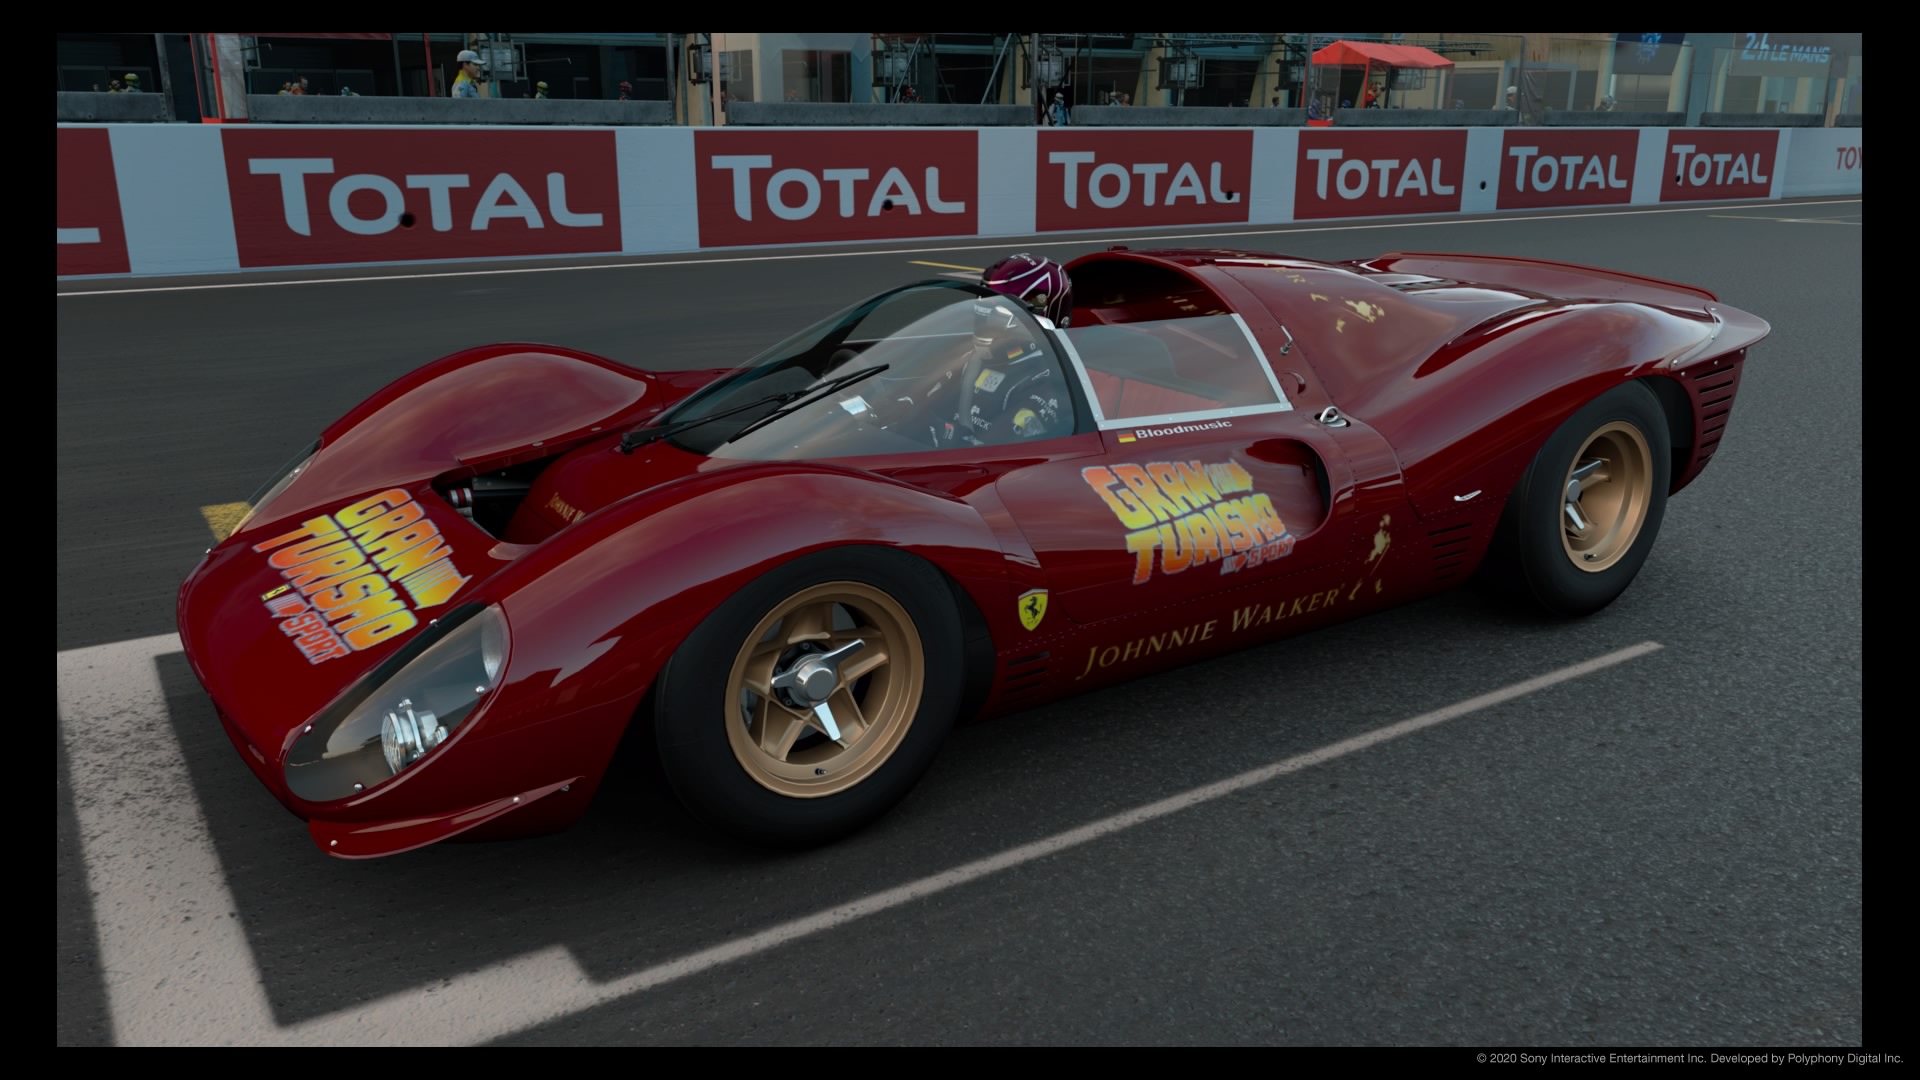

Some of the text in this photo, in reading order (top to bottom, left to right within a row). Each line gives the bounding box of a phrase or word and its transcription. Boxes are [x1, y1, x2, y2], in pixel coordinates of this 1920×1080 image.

[1771, 44, 1790, 61] LE
[1790, 45, 1831, 63] MANS
[711, 155, 966, 221] TOTAL
[1049, 152, 1240, 208] TOTAL
[1307, 149, 1455, 200] TOTAL
[1509, 146, 1628, 193] TOTAL
[1672, 144, 1768, 186] TOTAL
[248, 158, 603, 236] TOTAL
[1135, 420, 1233, 439] Bloodmusic
[1081, 460, 1223, 530] GRAN
[334, 488, 454, 583] GRAN
[1125, 493, 1287, 585] TURISMO
[1246, 534, 1296, 569] SPORT
[252, 514, 419, 651] TURISMO
[278, 611, 353, 666] SPORT
[1075, 587, 1341, 680] JOHNNIE WALKER
